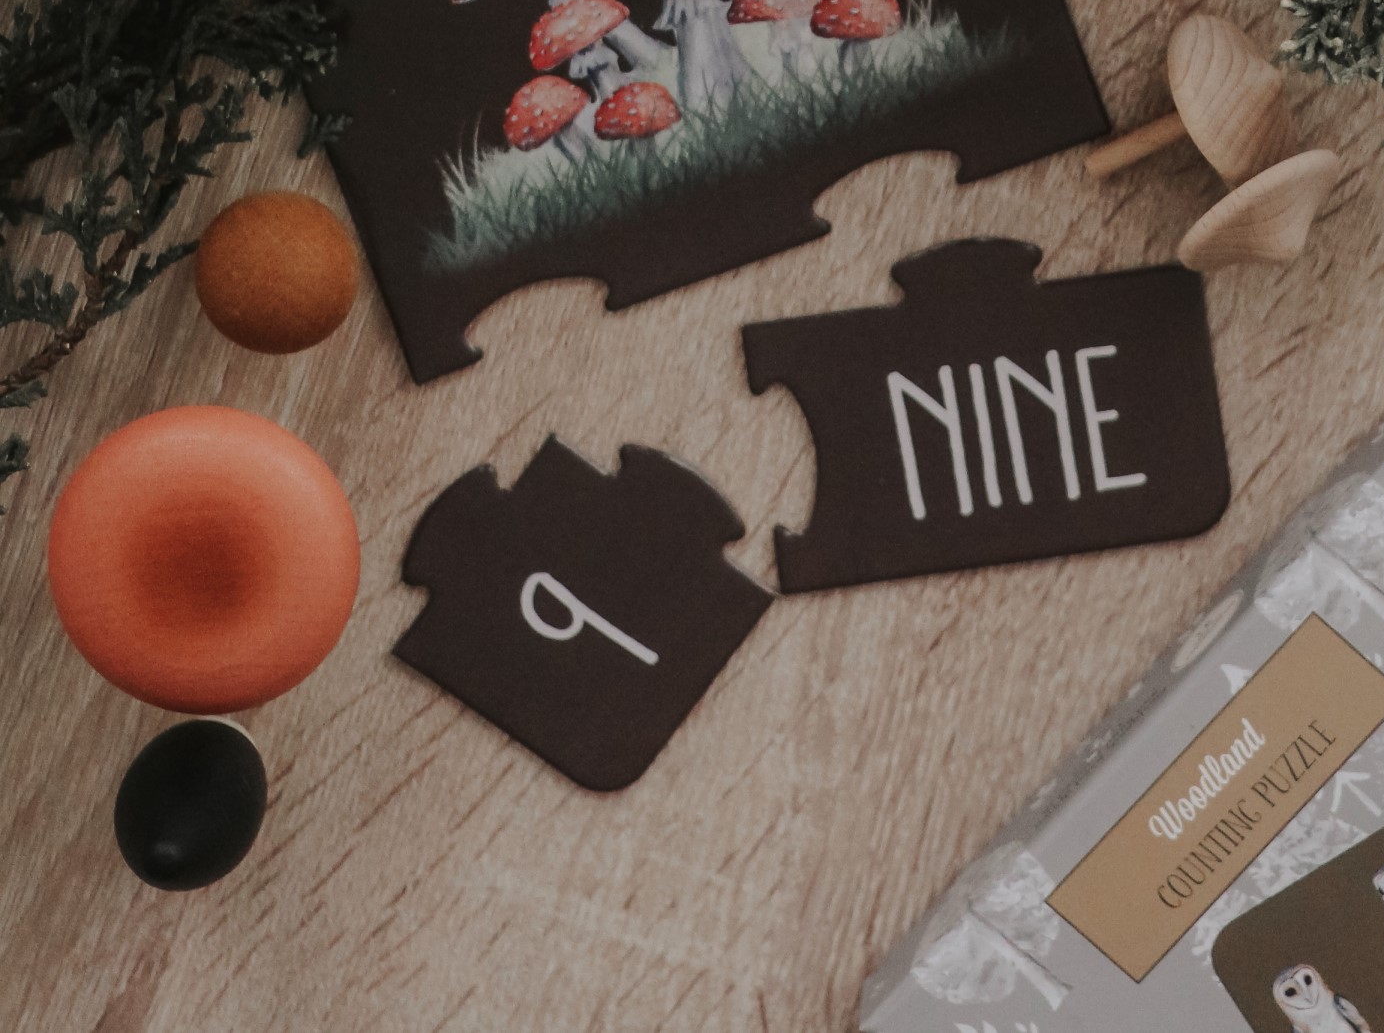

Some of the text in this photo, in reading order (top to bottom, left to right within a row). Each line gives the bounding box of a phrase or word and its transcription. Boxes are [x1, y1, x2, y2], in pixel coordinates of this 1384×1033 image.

[887, 345, 1147, 520] NINE
[520, 571, 659, 665] 9
[1149, 717, 1265, 839] Woodland
[1157, 719, 1336, 908] COUNTING PUZZLE
